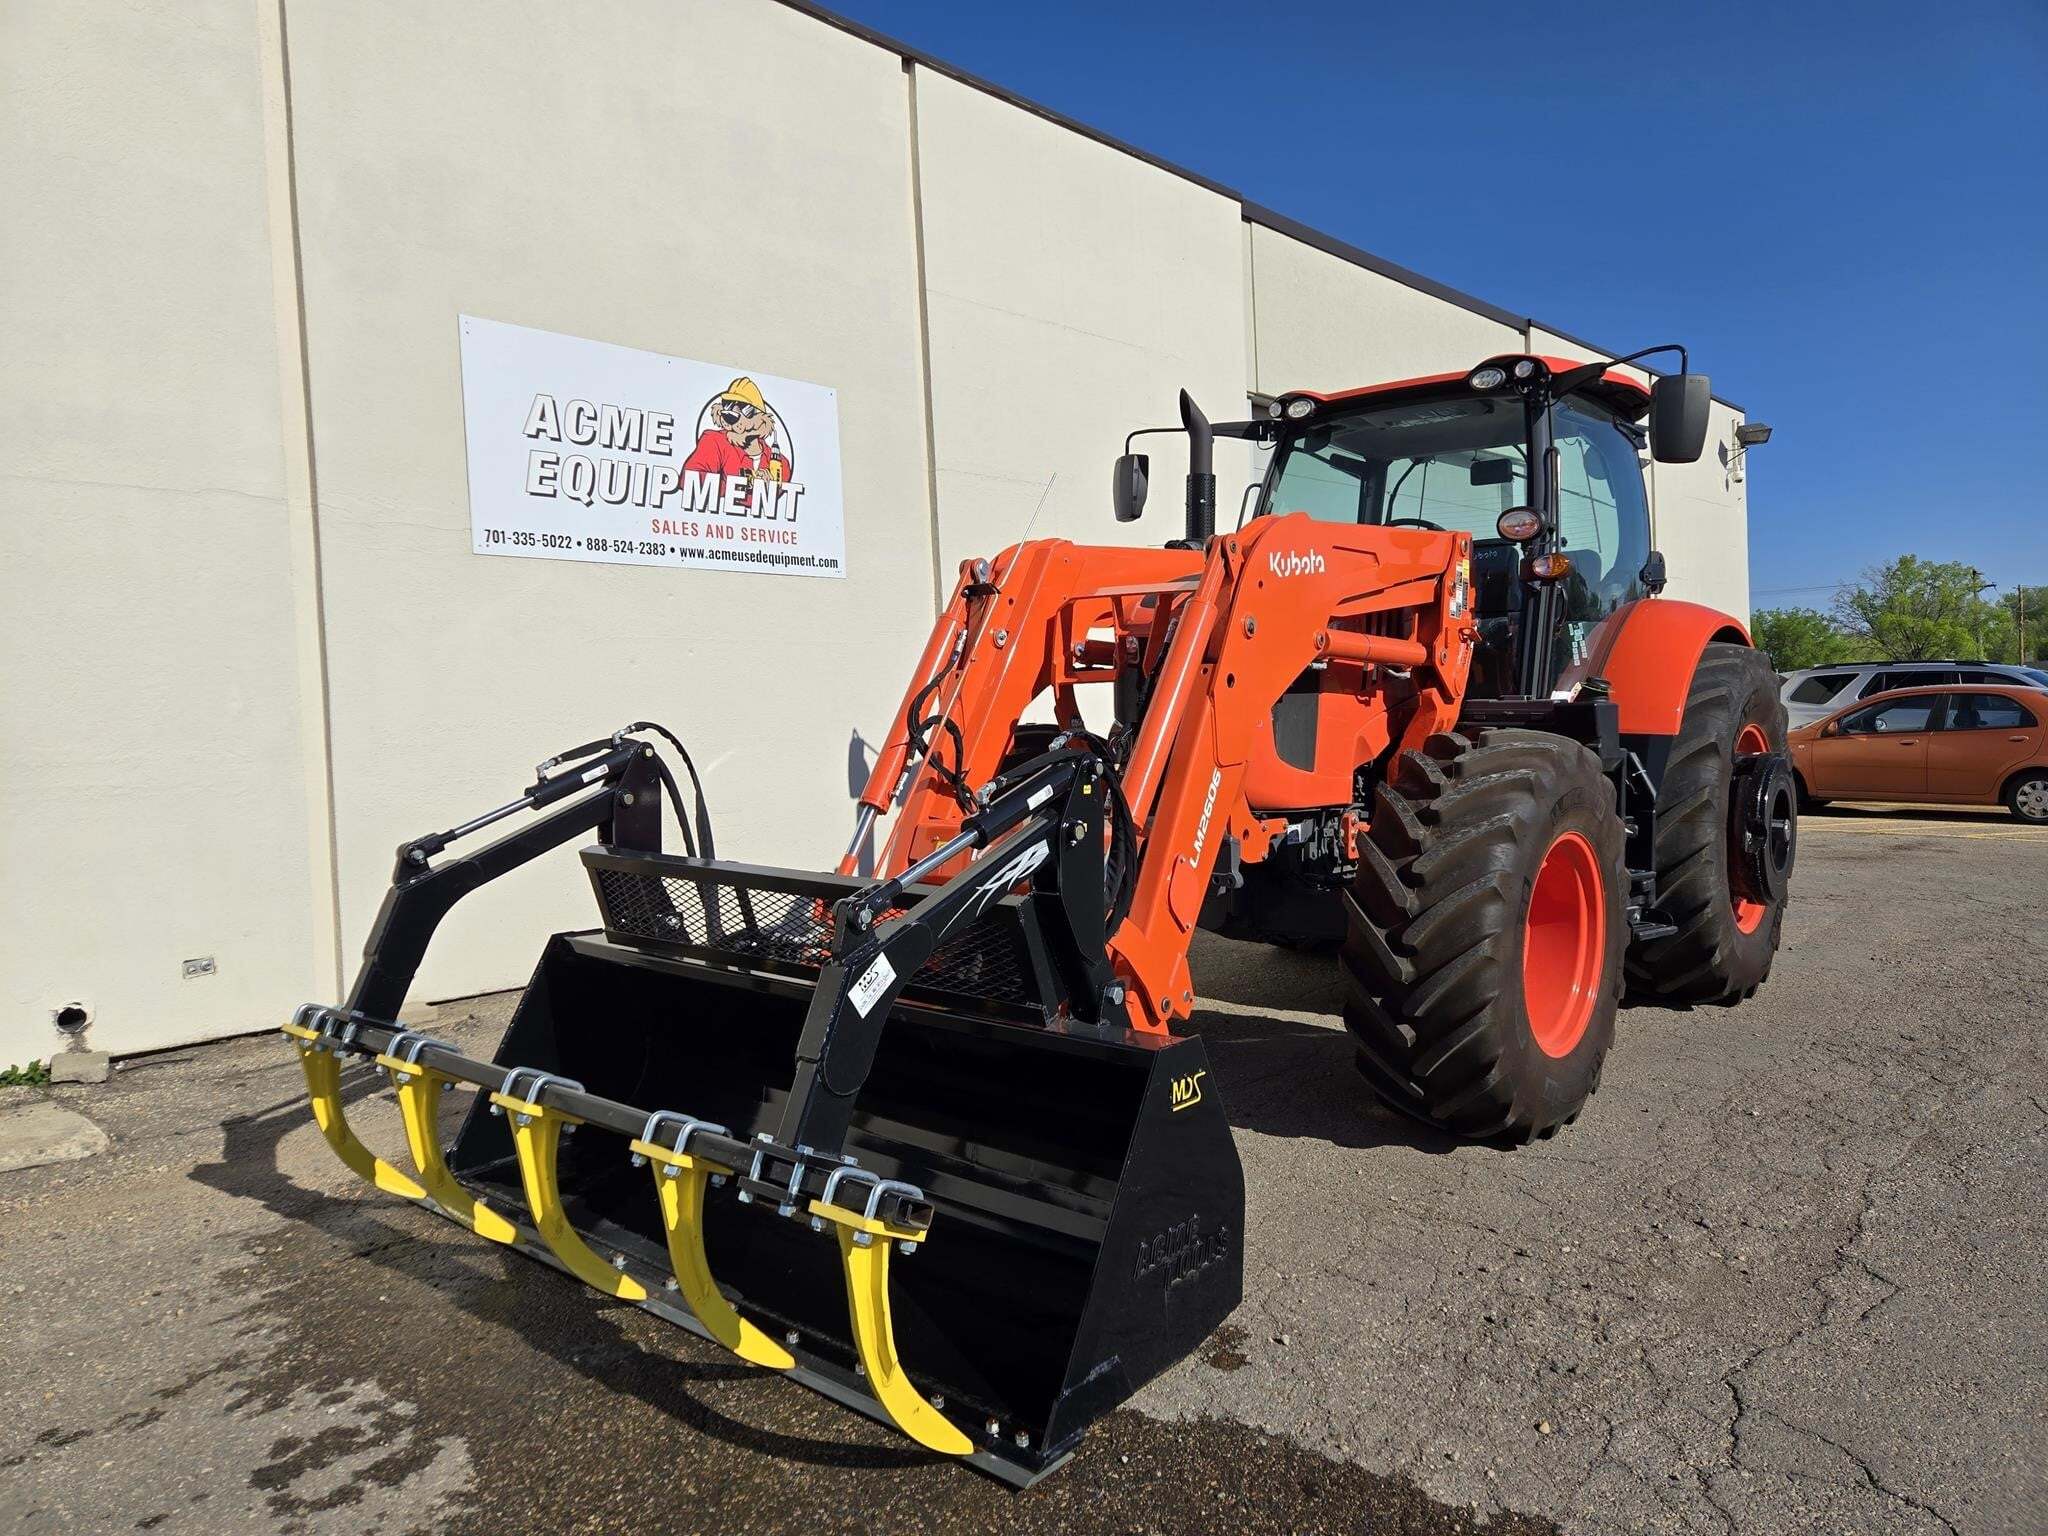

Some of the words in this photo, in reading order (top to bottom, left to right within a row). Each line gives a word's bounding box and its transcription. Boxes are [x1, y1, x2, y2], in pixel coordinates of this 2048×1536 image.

[522, 393, 674, 456] ACME
[525, 449, 805, 522] EQUIPMENT
[484, 528, 573, 550] 701-335-5022
[586, 537, 666, 557] 888-524-2383
[679, 544, 839, 569] www.acmeusedequipment.com
[652, 518, 699, 537] SALES
[705, 522, 735, 541] AND
[741, 526, 798, 545] SERVICE
[1269, 548, 1325, 577] Kubota
[1172, 1071, 1206, 1112] MDS
